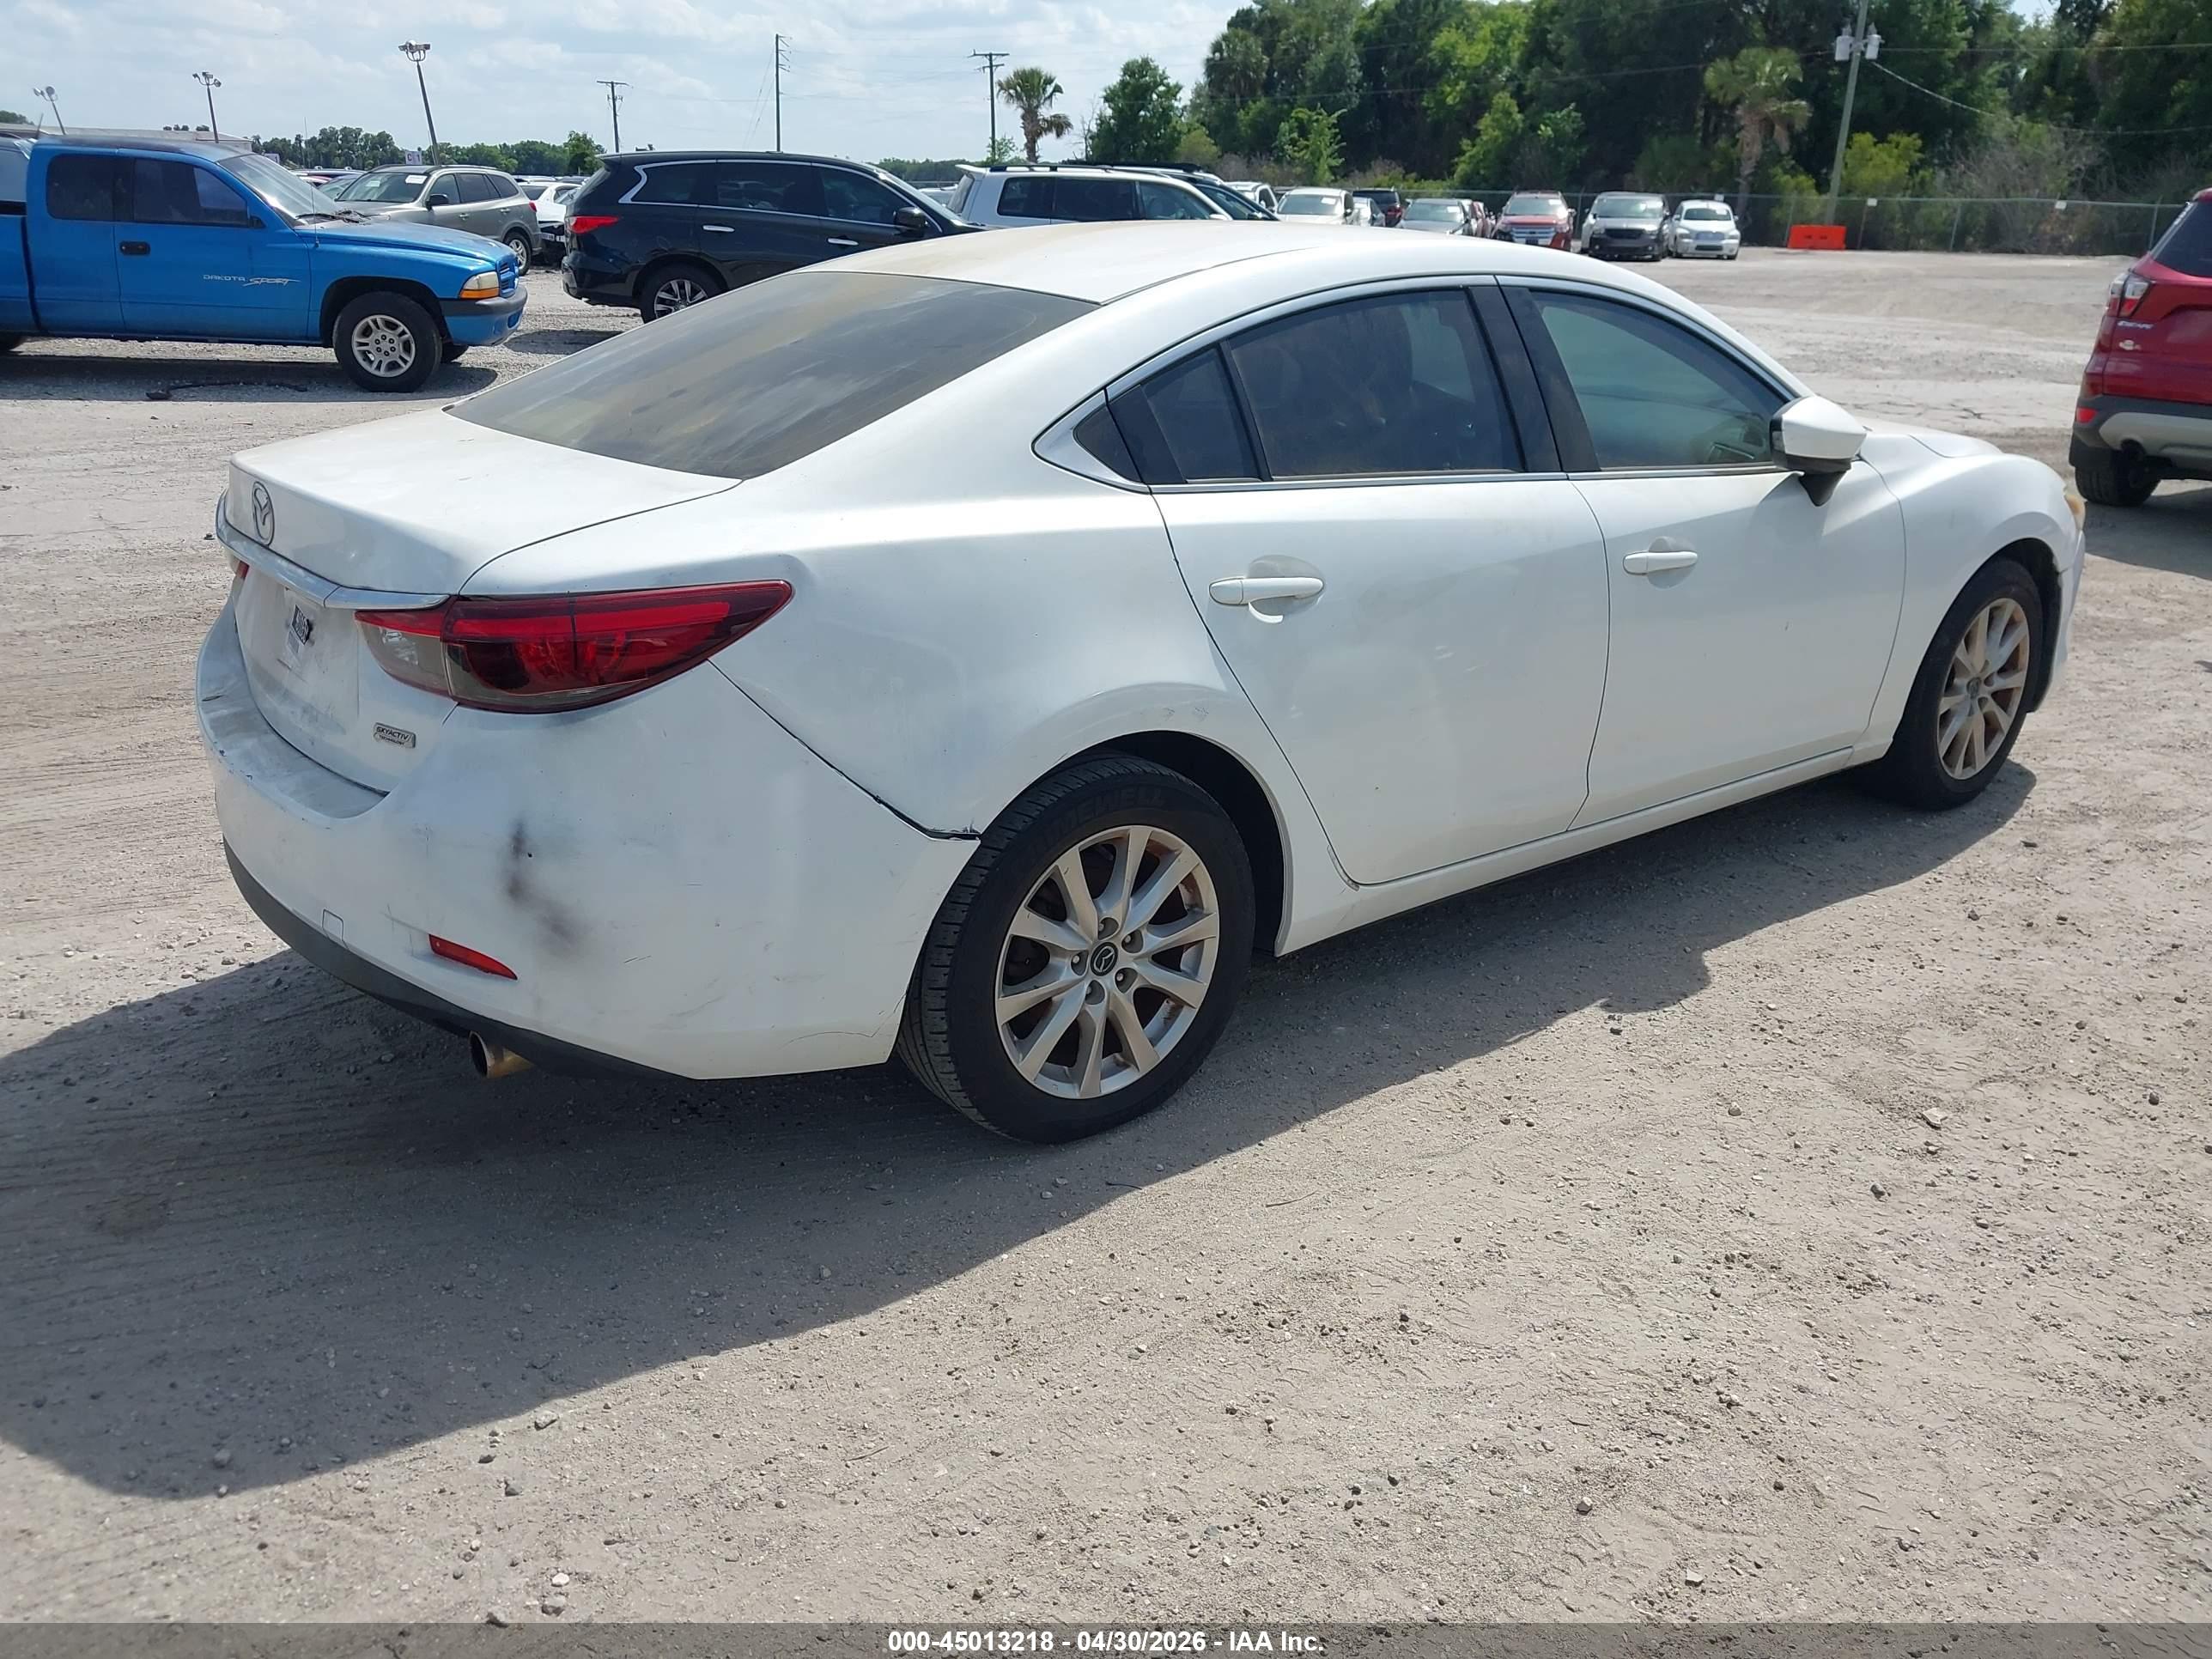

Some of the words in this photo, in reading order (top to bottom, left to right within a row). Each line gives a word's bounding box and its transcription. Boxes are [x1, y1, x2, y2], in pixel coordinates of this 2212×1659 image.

[203, 274, 246, 283] DAKOTA
[244, 277, 300, 286] SPORT
[376, 726, 410, 740] SKYACTIV
